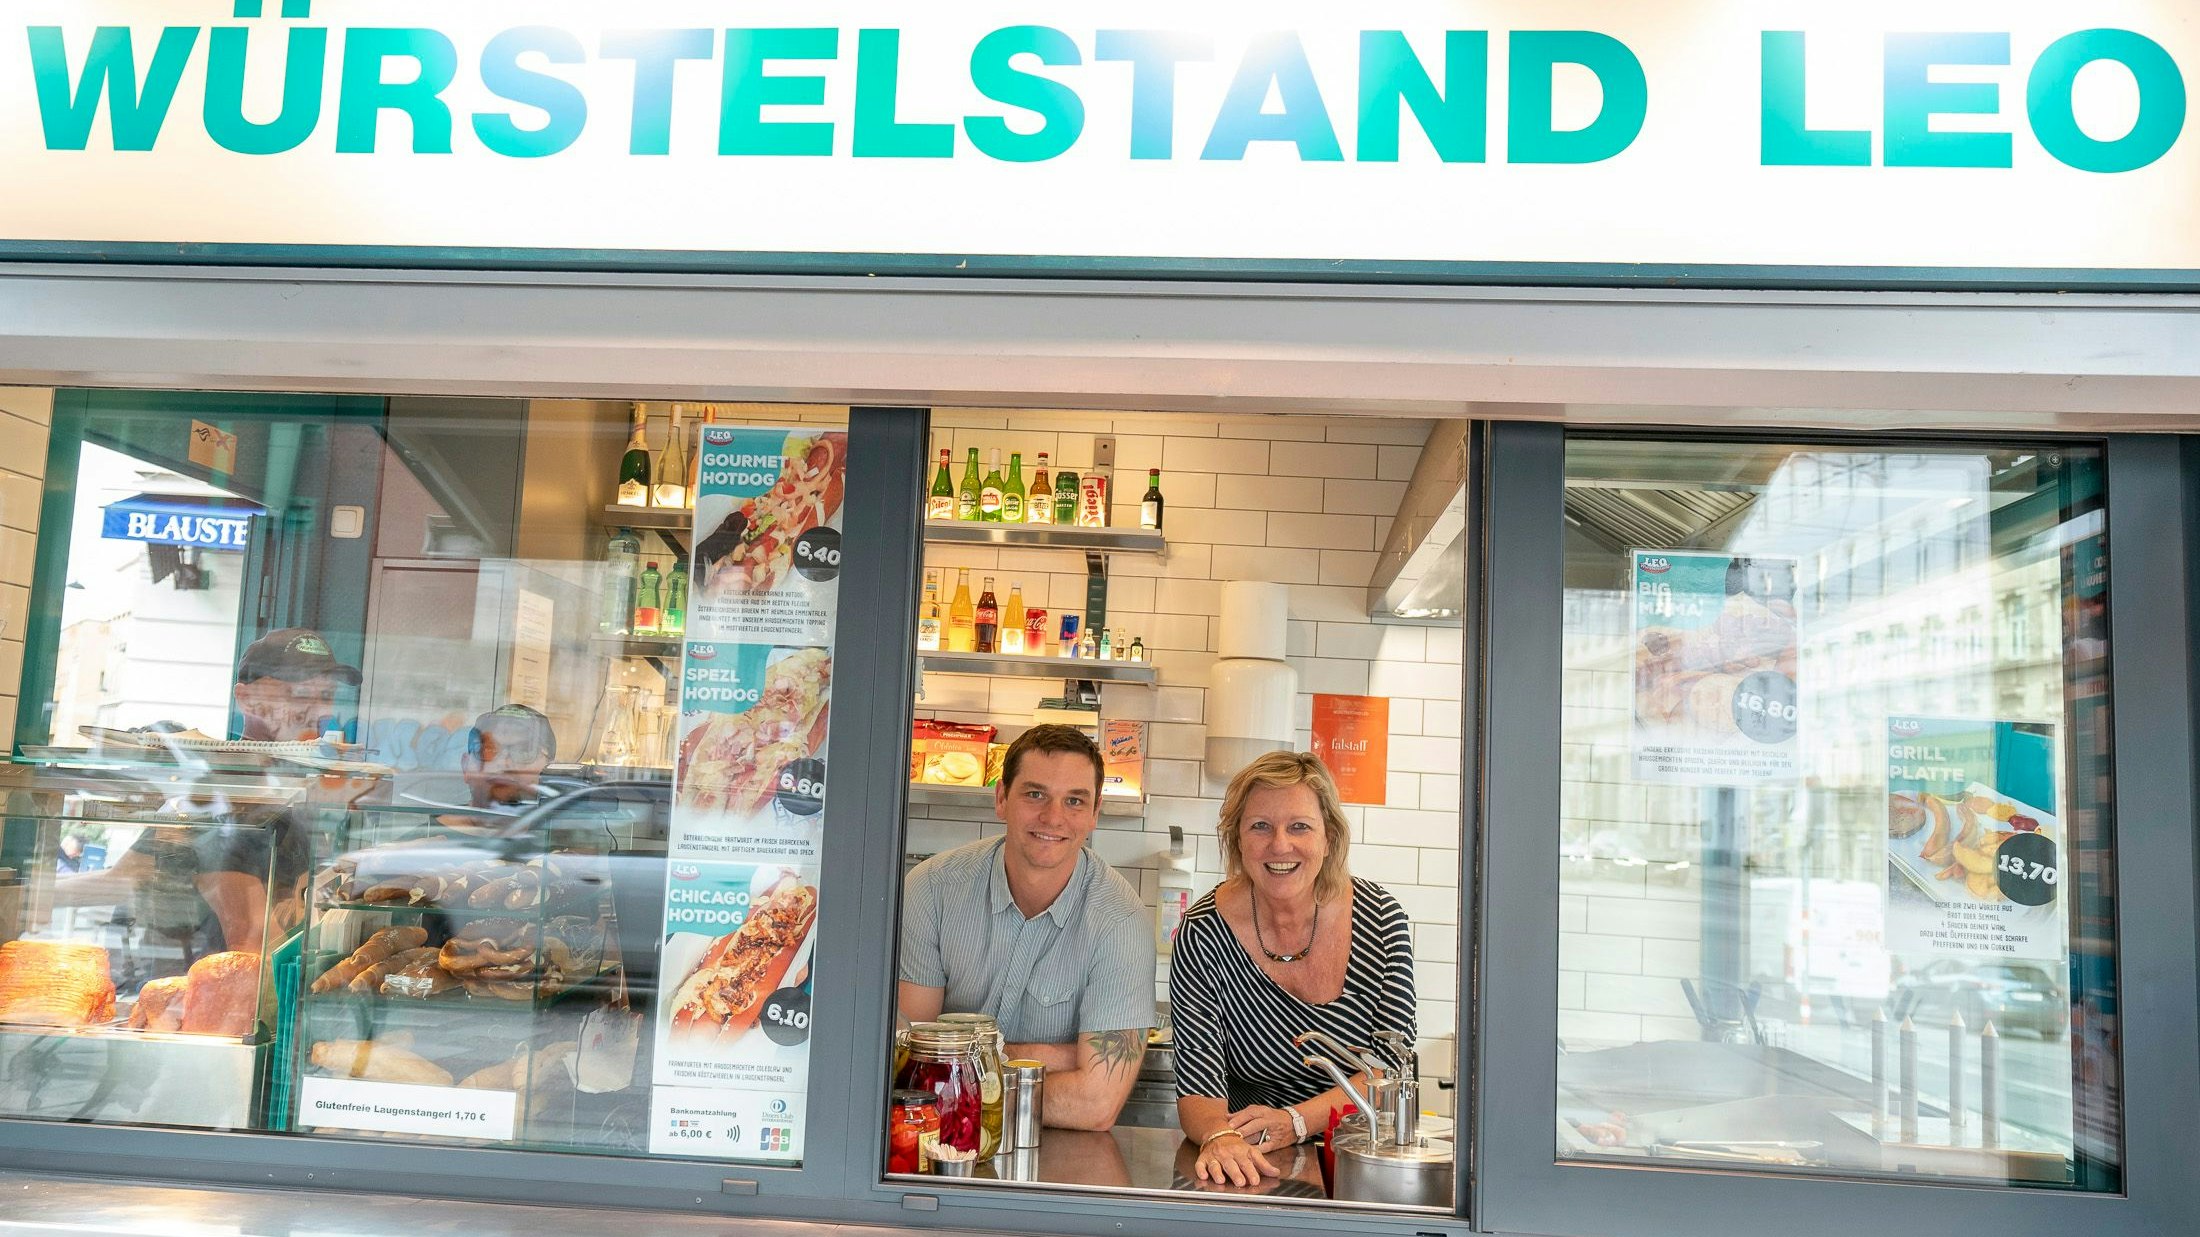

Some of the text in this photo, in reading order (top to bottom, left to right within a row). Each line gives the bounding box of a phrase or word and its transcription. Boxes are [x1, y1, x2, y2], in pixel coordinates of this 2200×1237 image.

[27, 0, 2187, 173] WÜRSTELSTAND LEO
[710, 430, 731, 440] LEO
[703, 453, 789, 469] GOURMET
[702, 471, 776, 486] HOTDOG
[797, 540, 841, 566] 6,40
[1643, 557, 1668, 567] LEO
[1639, 581, 1672, 597] BIG
[692, 644, 714, 654] LEO
[686, 668, 741, 683] SPEZL
[685, 686, 759, 701] HOTDOG
[1737, 692, 1797, 722] 16,80
[1894, 719, 1919, 730] LEO
[1331, 737, 1369, 752] falstaff
[1889, 745, 1946, 761] GRILL
[1889, 764, 1965, 782] PLATTE
[780, 772, 825, 799] 6,60
[676, 865, 698, 875] LEO
[1998, 854, 2057, 885] 13,70
[669, 888, 750, 906] CHICAGO
[668, 907, 743, 925] HOTDOG
[767, 1003, 809, 1030] 6,10
[315, 1100, 486, 1121] Glutenfreie Laugenstangerl 1,70 €
[670, 1107, 737, 1118] Bankomatzahlung
[680, 1129, 702, 1138] 6,00
[705, 1130, 712, 1138] €
